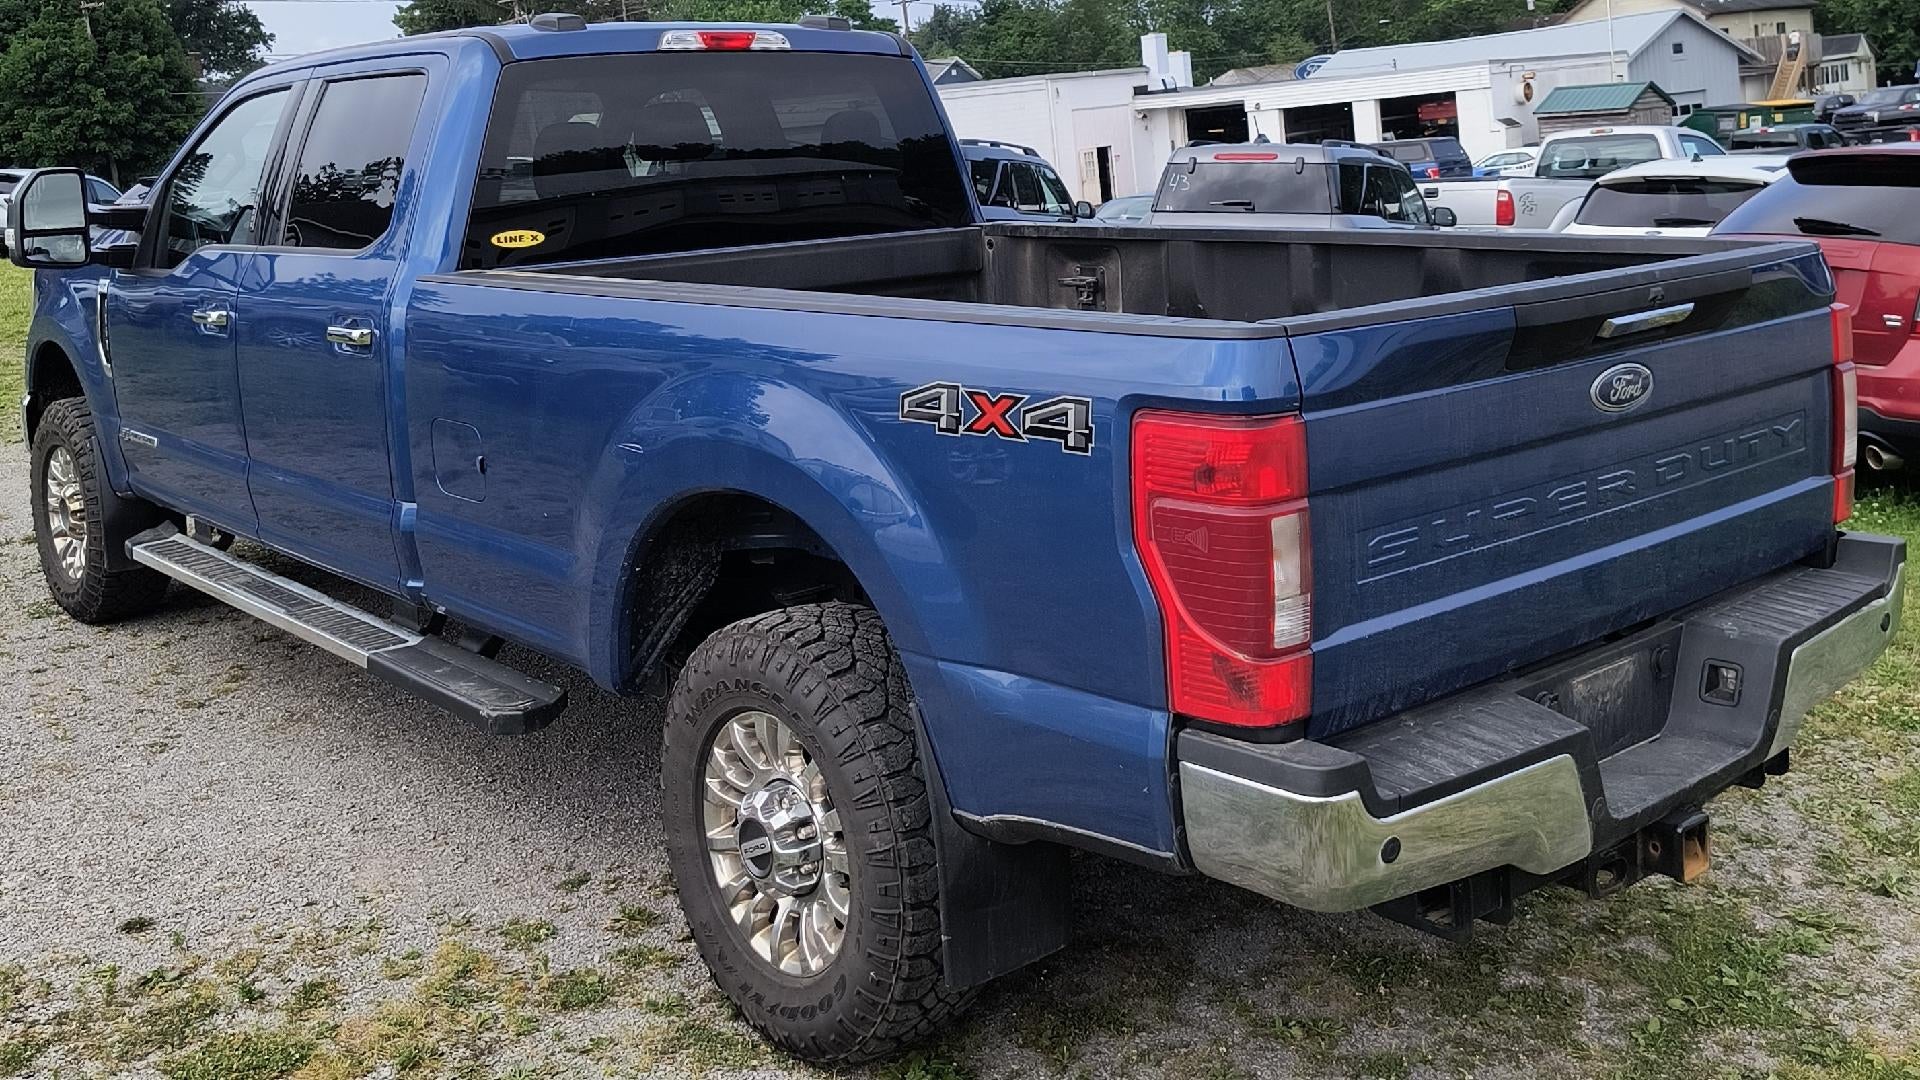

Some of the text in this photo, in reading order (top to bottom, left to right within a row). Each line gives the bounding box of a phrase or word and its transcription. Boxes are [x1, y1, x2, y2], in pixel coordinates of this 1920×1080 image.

[1169, 173, 1190, 192] 43
[495, 234, 540, 244] LINE-X
[1610, 373, 1643, 402] Ford
[1367, 417, 1801, 565] SUPER DUTY
[744, 842, 767, 854] FORD
